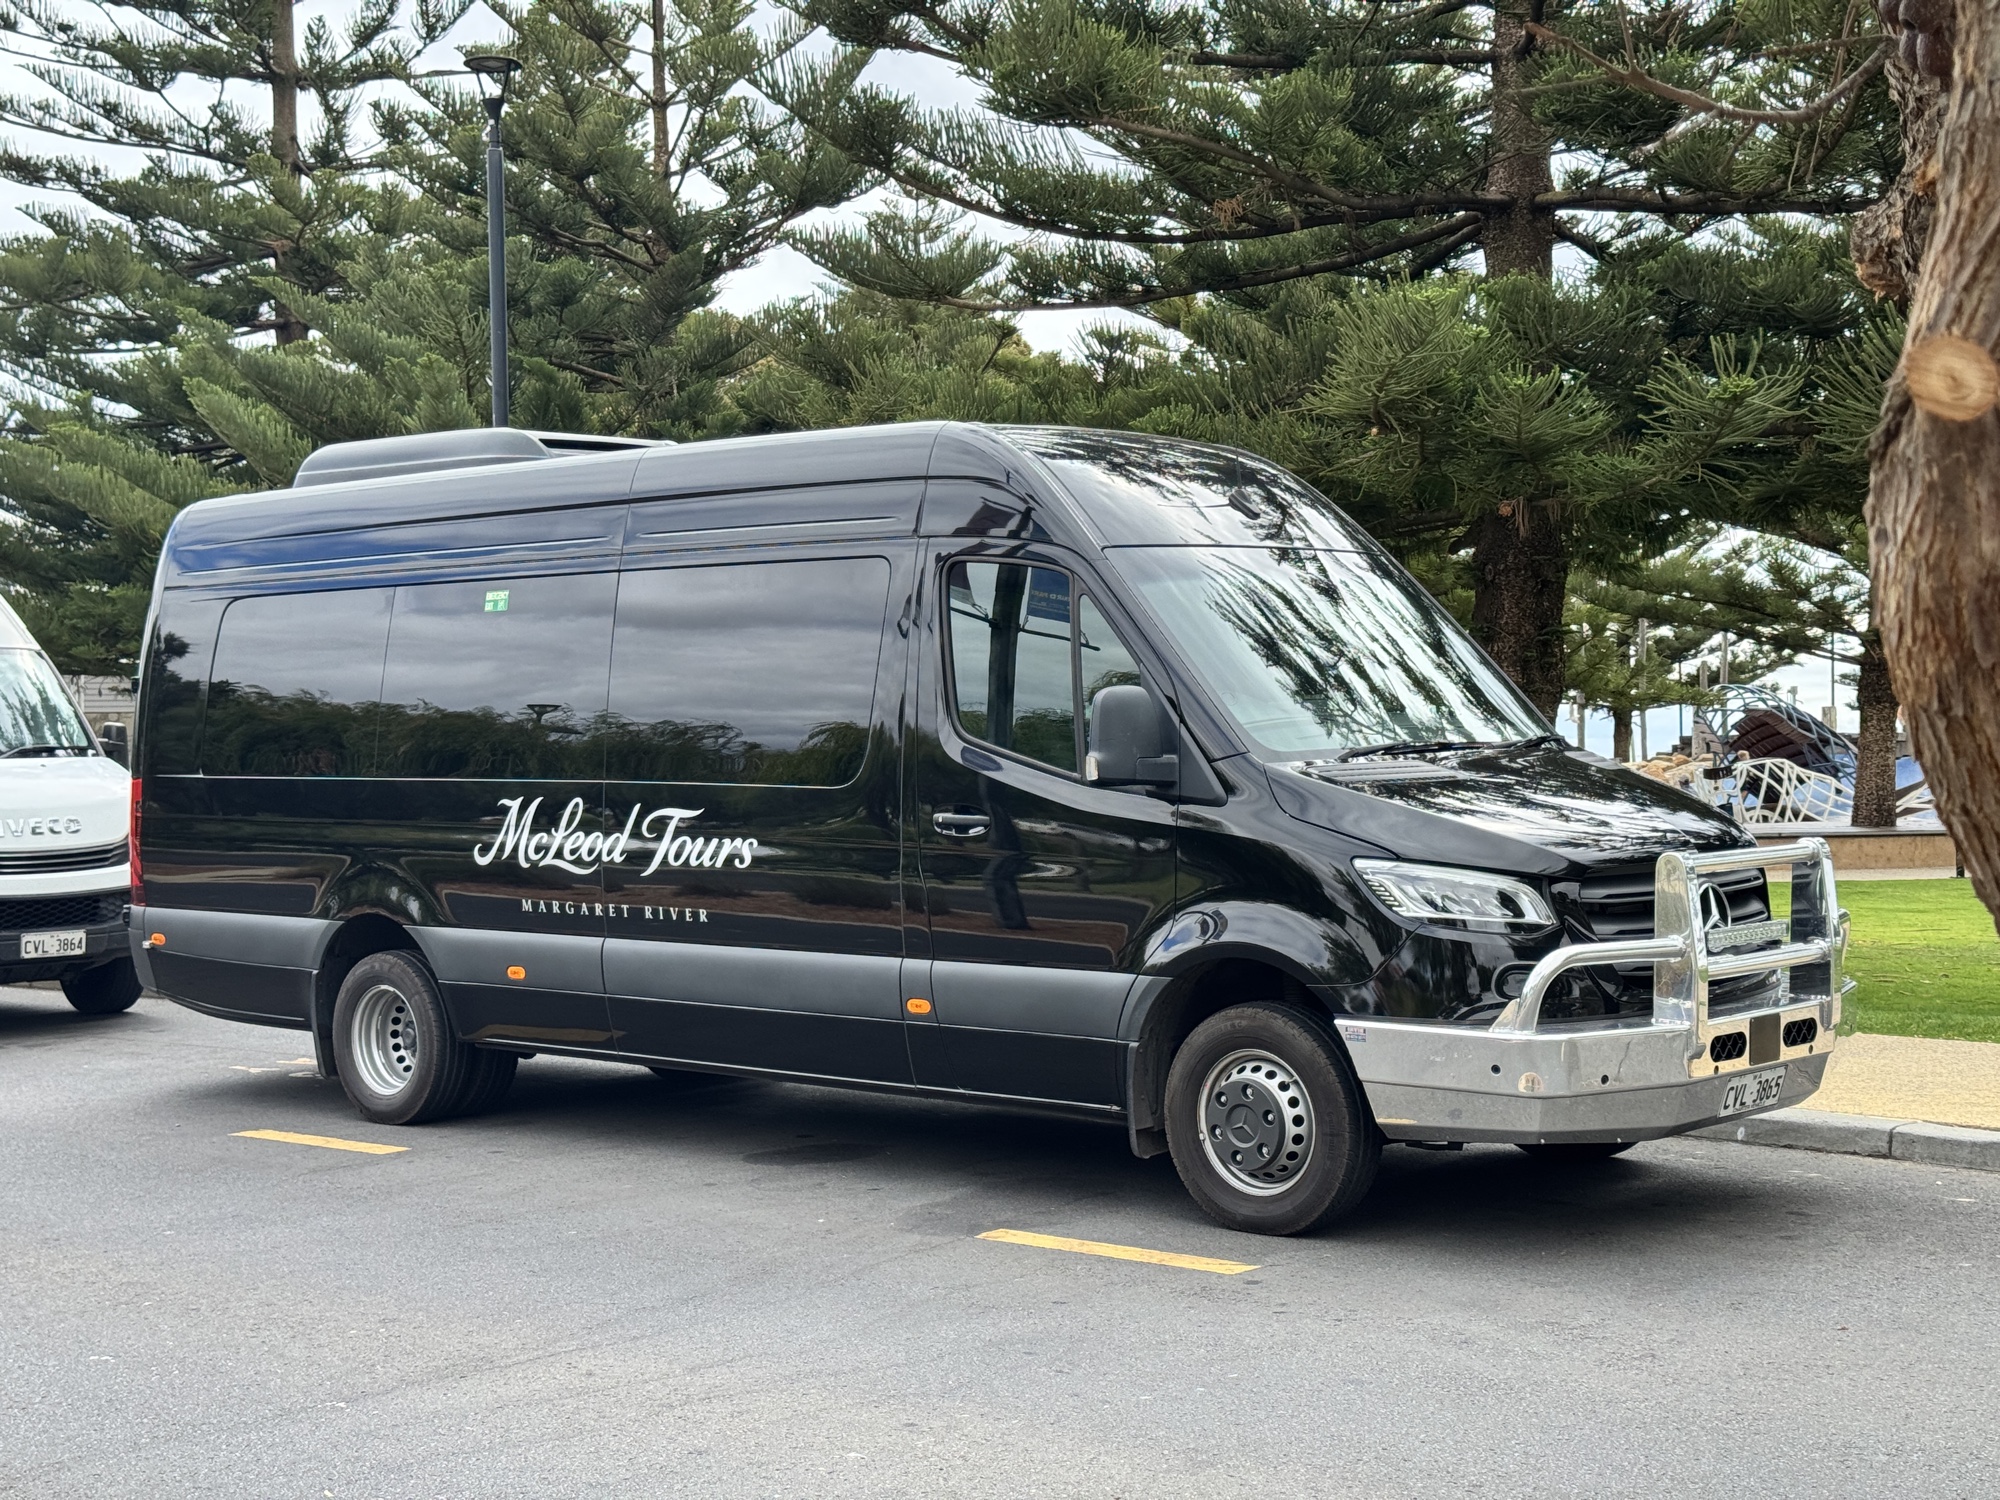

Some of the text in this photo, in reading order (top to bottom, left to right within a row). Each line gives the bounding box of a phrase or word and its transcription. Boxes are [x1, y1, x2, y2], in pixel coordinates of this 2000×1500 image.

[0, 816, 82, 837] IVECO
[474, 796, 759, 876] McLeod Tours
[521, 898, 708, 922] MARGARET RIVER
